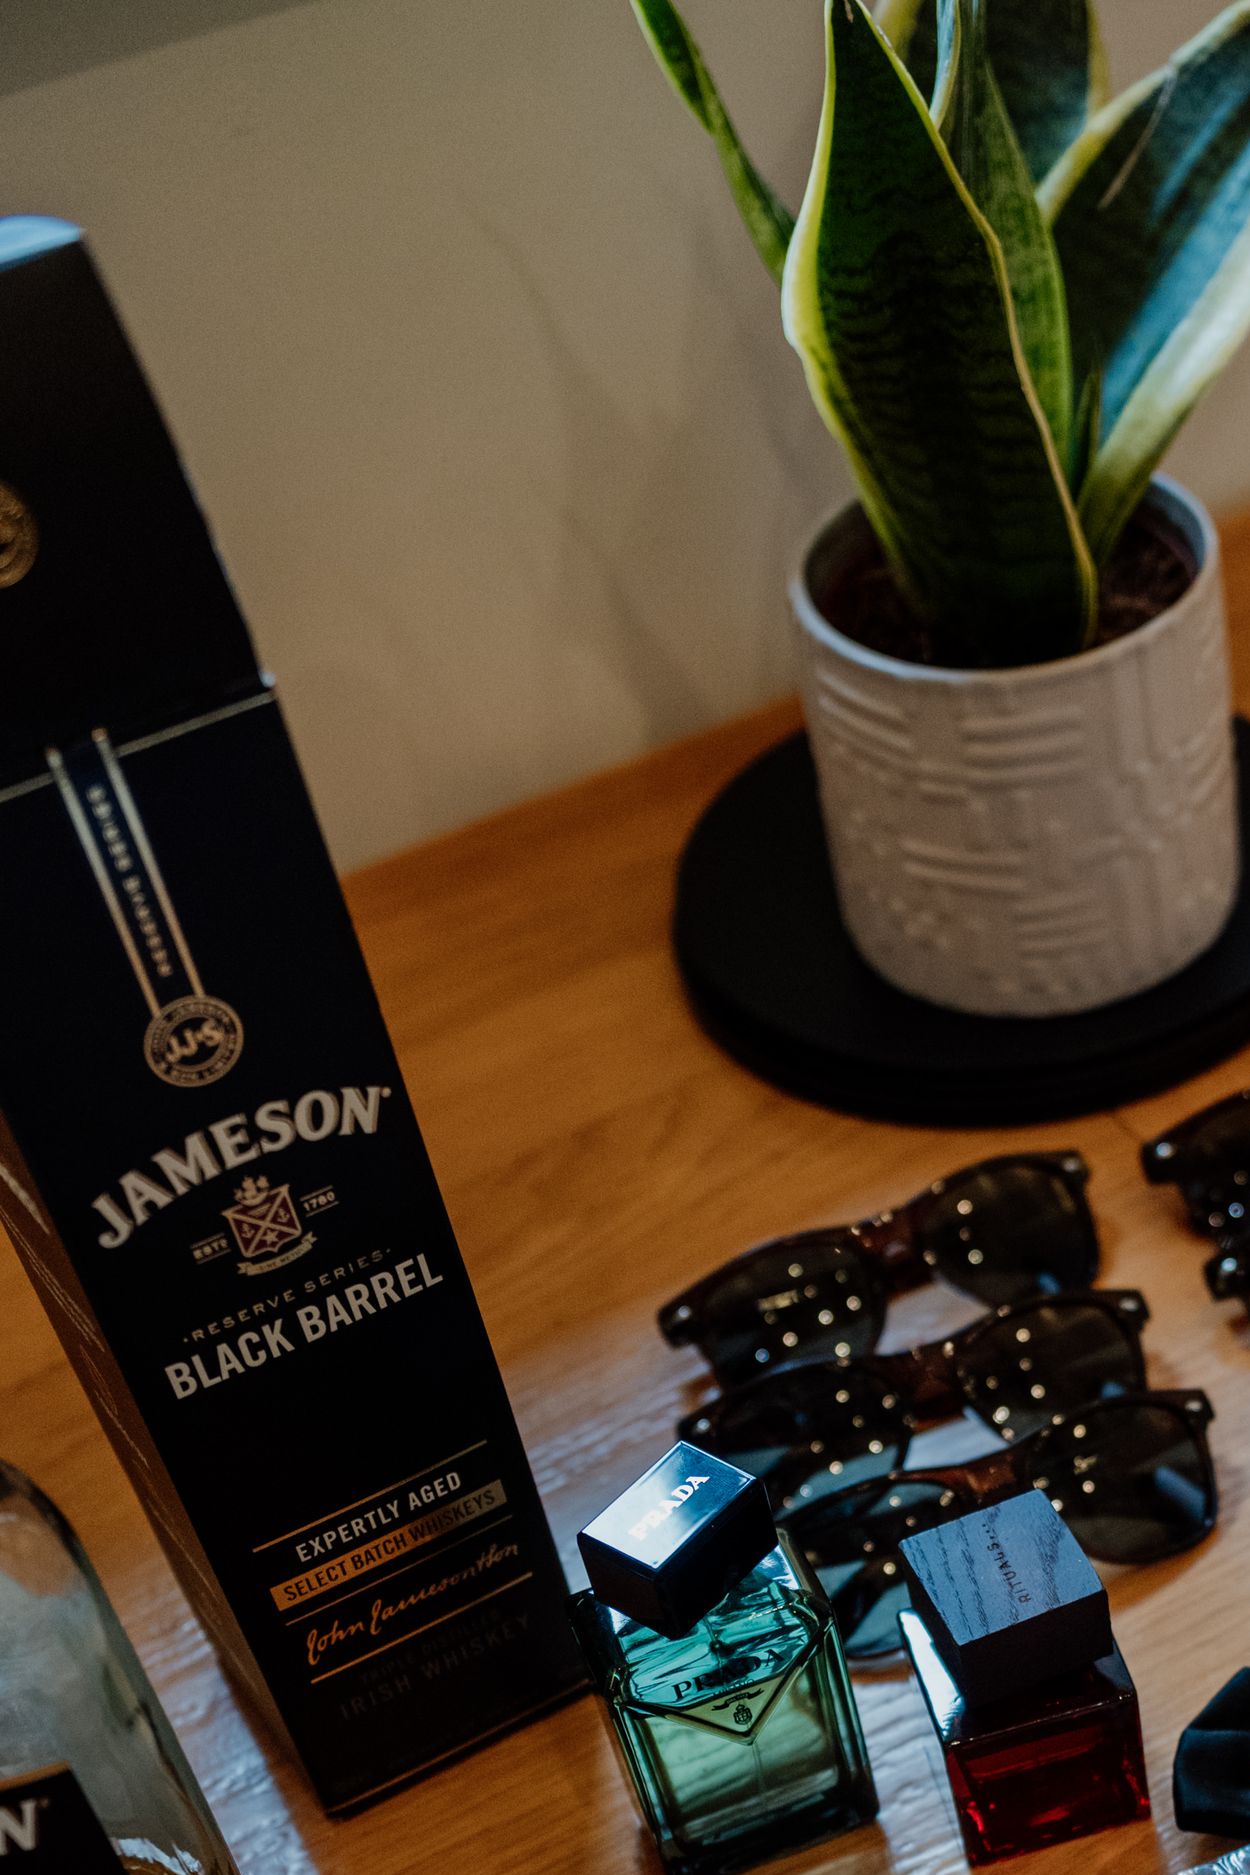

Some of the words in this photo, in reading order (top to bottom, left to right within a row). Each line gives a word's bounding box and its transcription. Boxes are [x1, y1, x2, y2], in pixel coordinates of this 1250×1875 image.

[91, 1085, 383, 1250] JAMESON
[163, 1317, 297, 1401] BLACK
[296, 1252, 444, 1344] BARREL
[189, 1288, 297, 1342] RESERVE
[303, 1249, 386, 1294] SERIES
[283, 1560, 349, 1603] SELECT
[350, 1534, 407, 1571] BATCH
[409, 1488, 497, 1543] WHISKEYS
[294, 1499, 401, 1564] EXPERTLY
[407, 1470, 462, 1512] AGED
[627, 1475, 711, 1541] PRADA
[671, 1648, 788, 1701] PRDA
